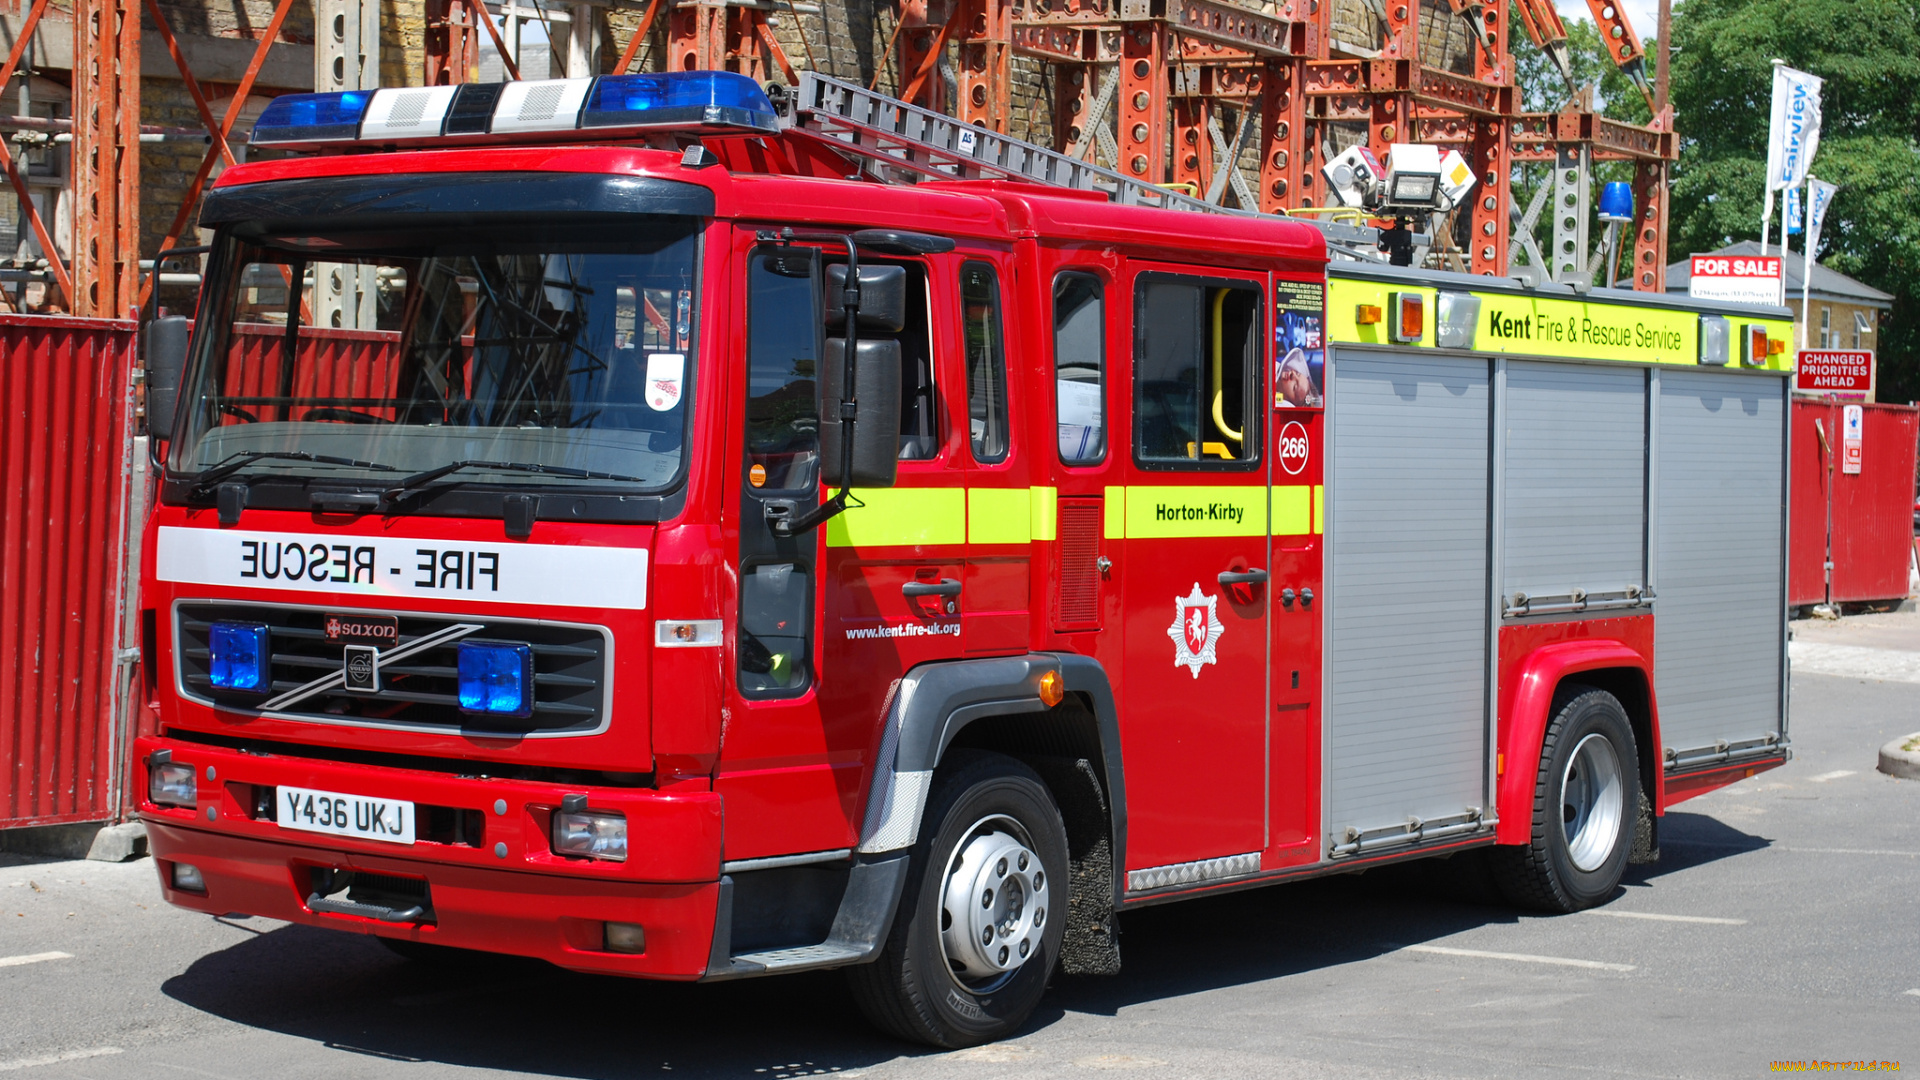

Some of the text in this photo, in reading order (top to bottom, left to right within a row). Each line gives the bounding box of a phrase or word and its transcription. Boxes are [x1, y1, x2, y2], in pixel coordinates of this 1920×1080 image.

[1782, 83, 1807, 181] Fairview
[1694, 259, 1778, 276] FOR SALE
[1490, 310, 1681, 350] Kent Fire & Rescue Service
[1804, 353, 1865, 365] CHANGED
[1801, 365, 1868, 376] PRIORITIES
[1813, 376, 1855, 387] AHEAD
[1282, 437, 1306, 458] 266
[342, 623, 396, 638] saxon
[845, 622, 961, 640] www.kent.fire-uk.org
[287, 792, 403, 836] Y436 UKJ
